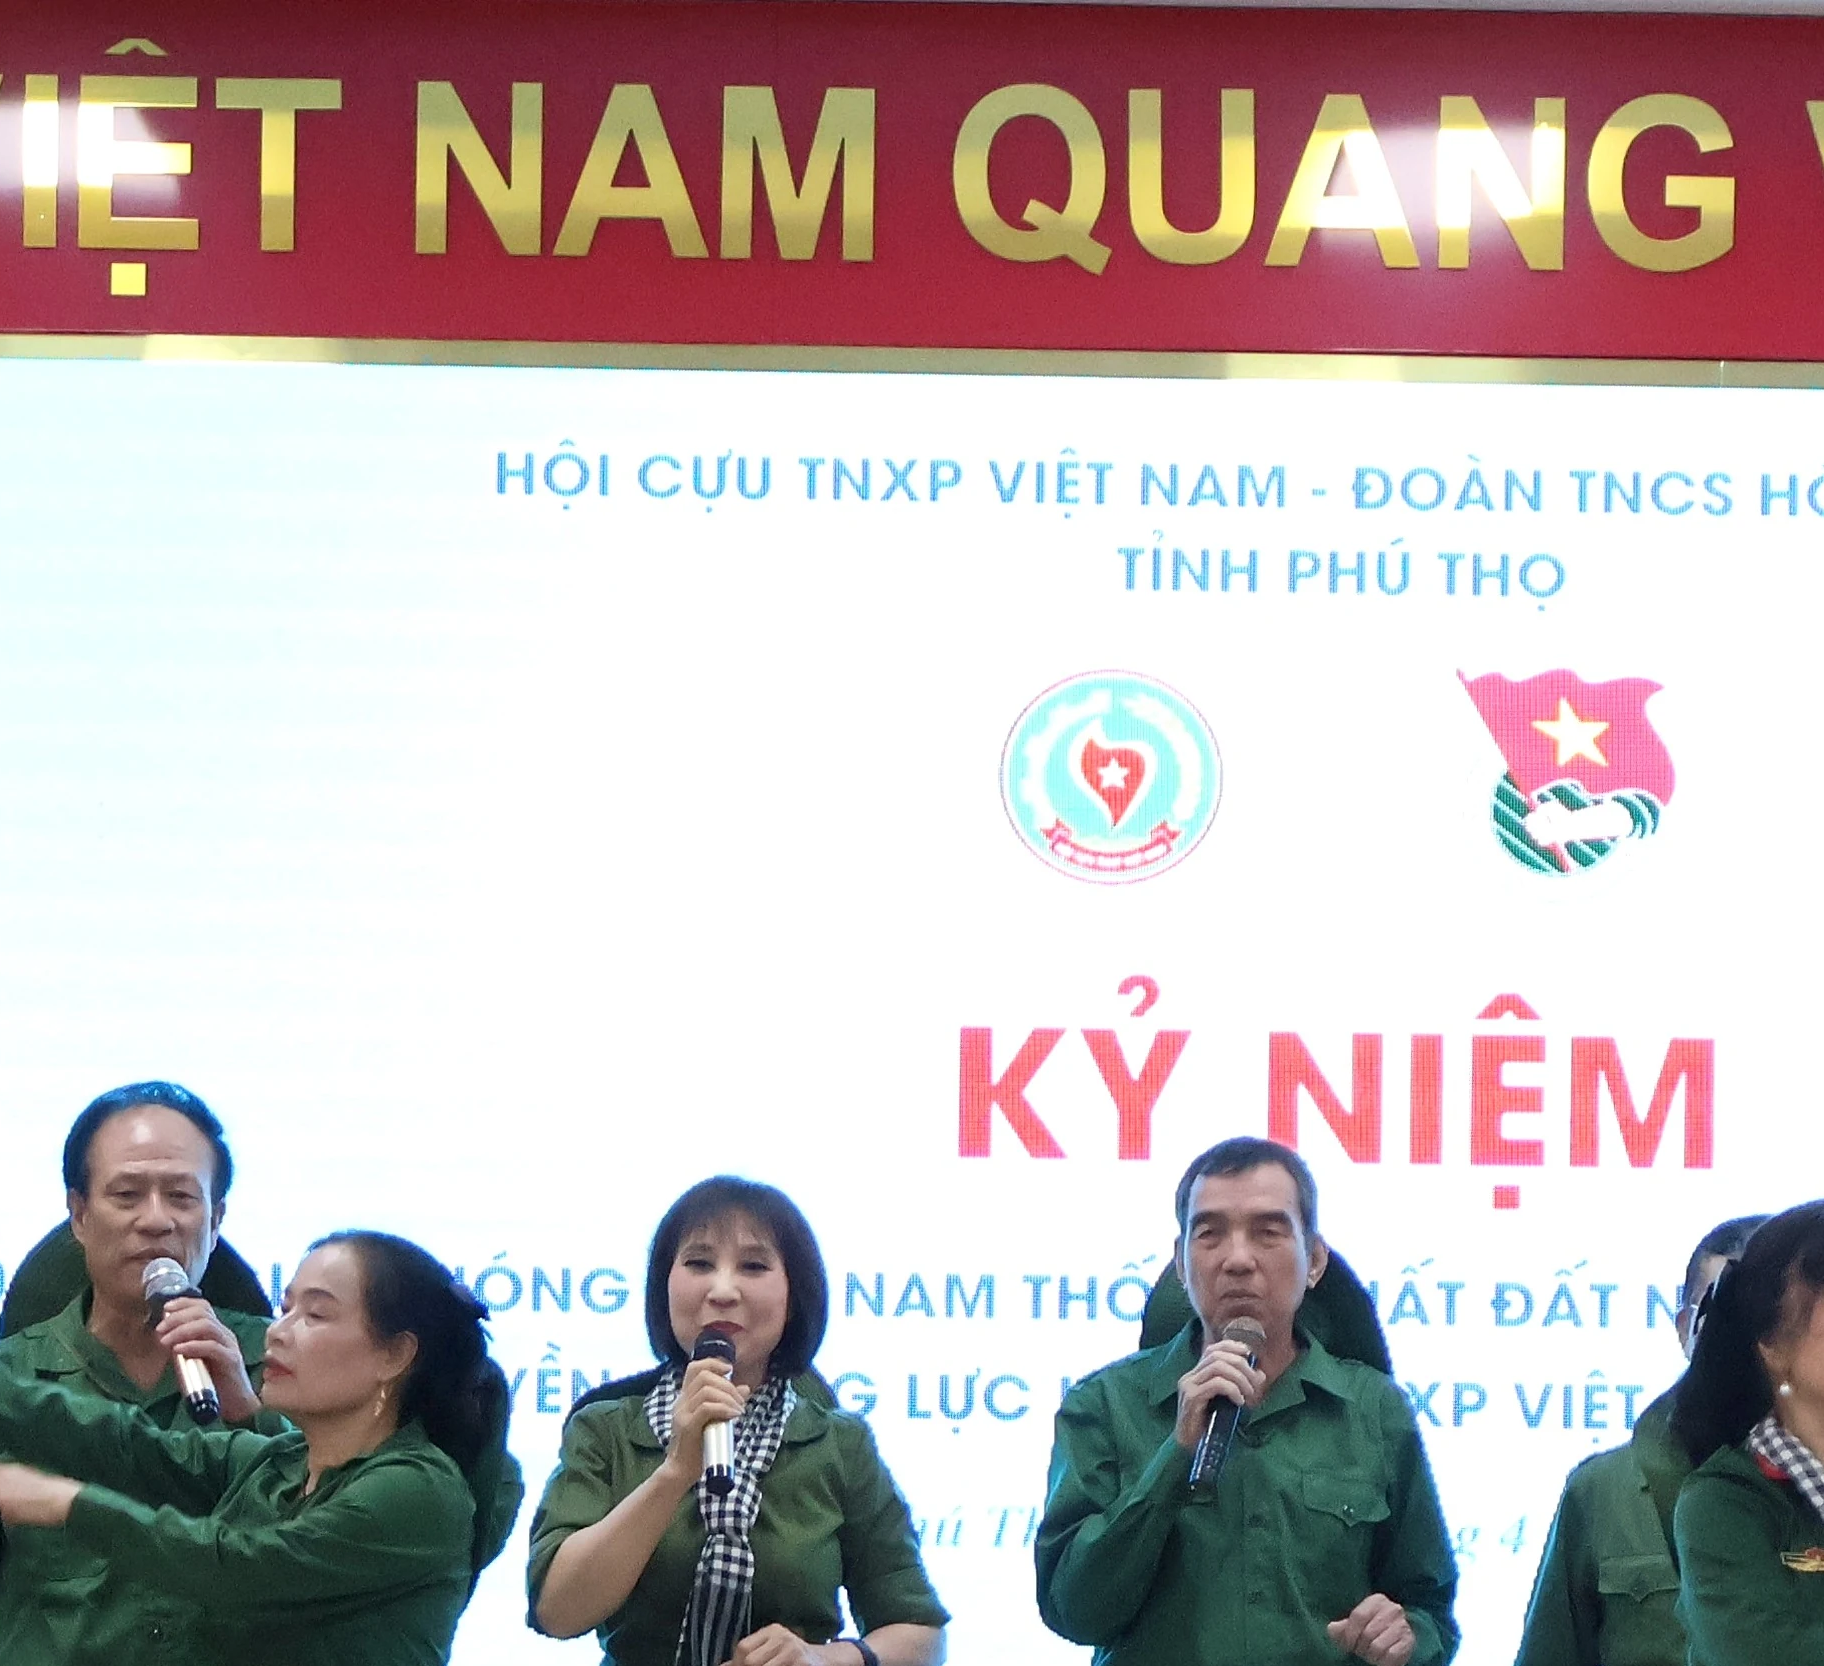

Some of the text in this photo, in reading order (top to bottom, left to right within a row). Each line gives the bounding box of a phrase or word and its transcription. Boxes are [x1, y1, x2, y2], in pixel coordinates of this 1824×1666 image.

[414, 80, 877, 262] NAM
[952, 82, 1737, 275] QUANG
[495, 438, 611, 511] HỘI
[636, 449, 772, 514] CỰU
[797, 456, 964, 504] TNXP
[988, 447, 1115, 519] VIỆT
[1140, 463, 1286, 509] NAM
[1351, 454, 1543, 513] ĐOÀN
[1568, 469, 1734, 517] TNCS
[1116, 529, 1567, 612] TỈNH PHÚ THỌ
[957, 974, 1716, 1210] KỶ NIỆM
[844, 1271, 996, 1320] NAM
[1489, 1259, 1619, 1329] ĐẤT
[906, 1366, 1030, 1436] LỰC
[1513, 1368, 1645, 1445] VIỆT
